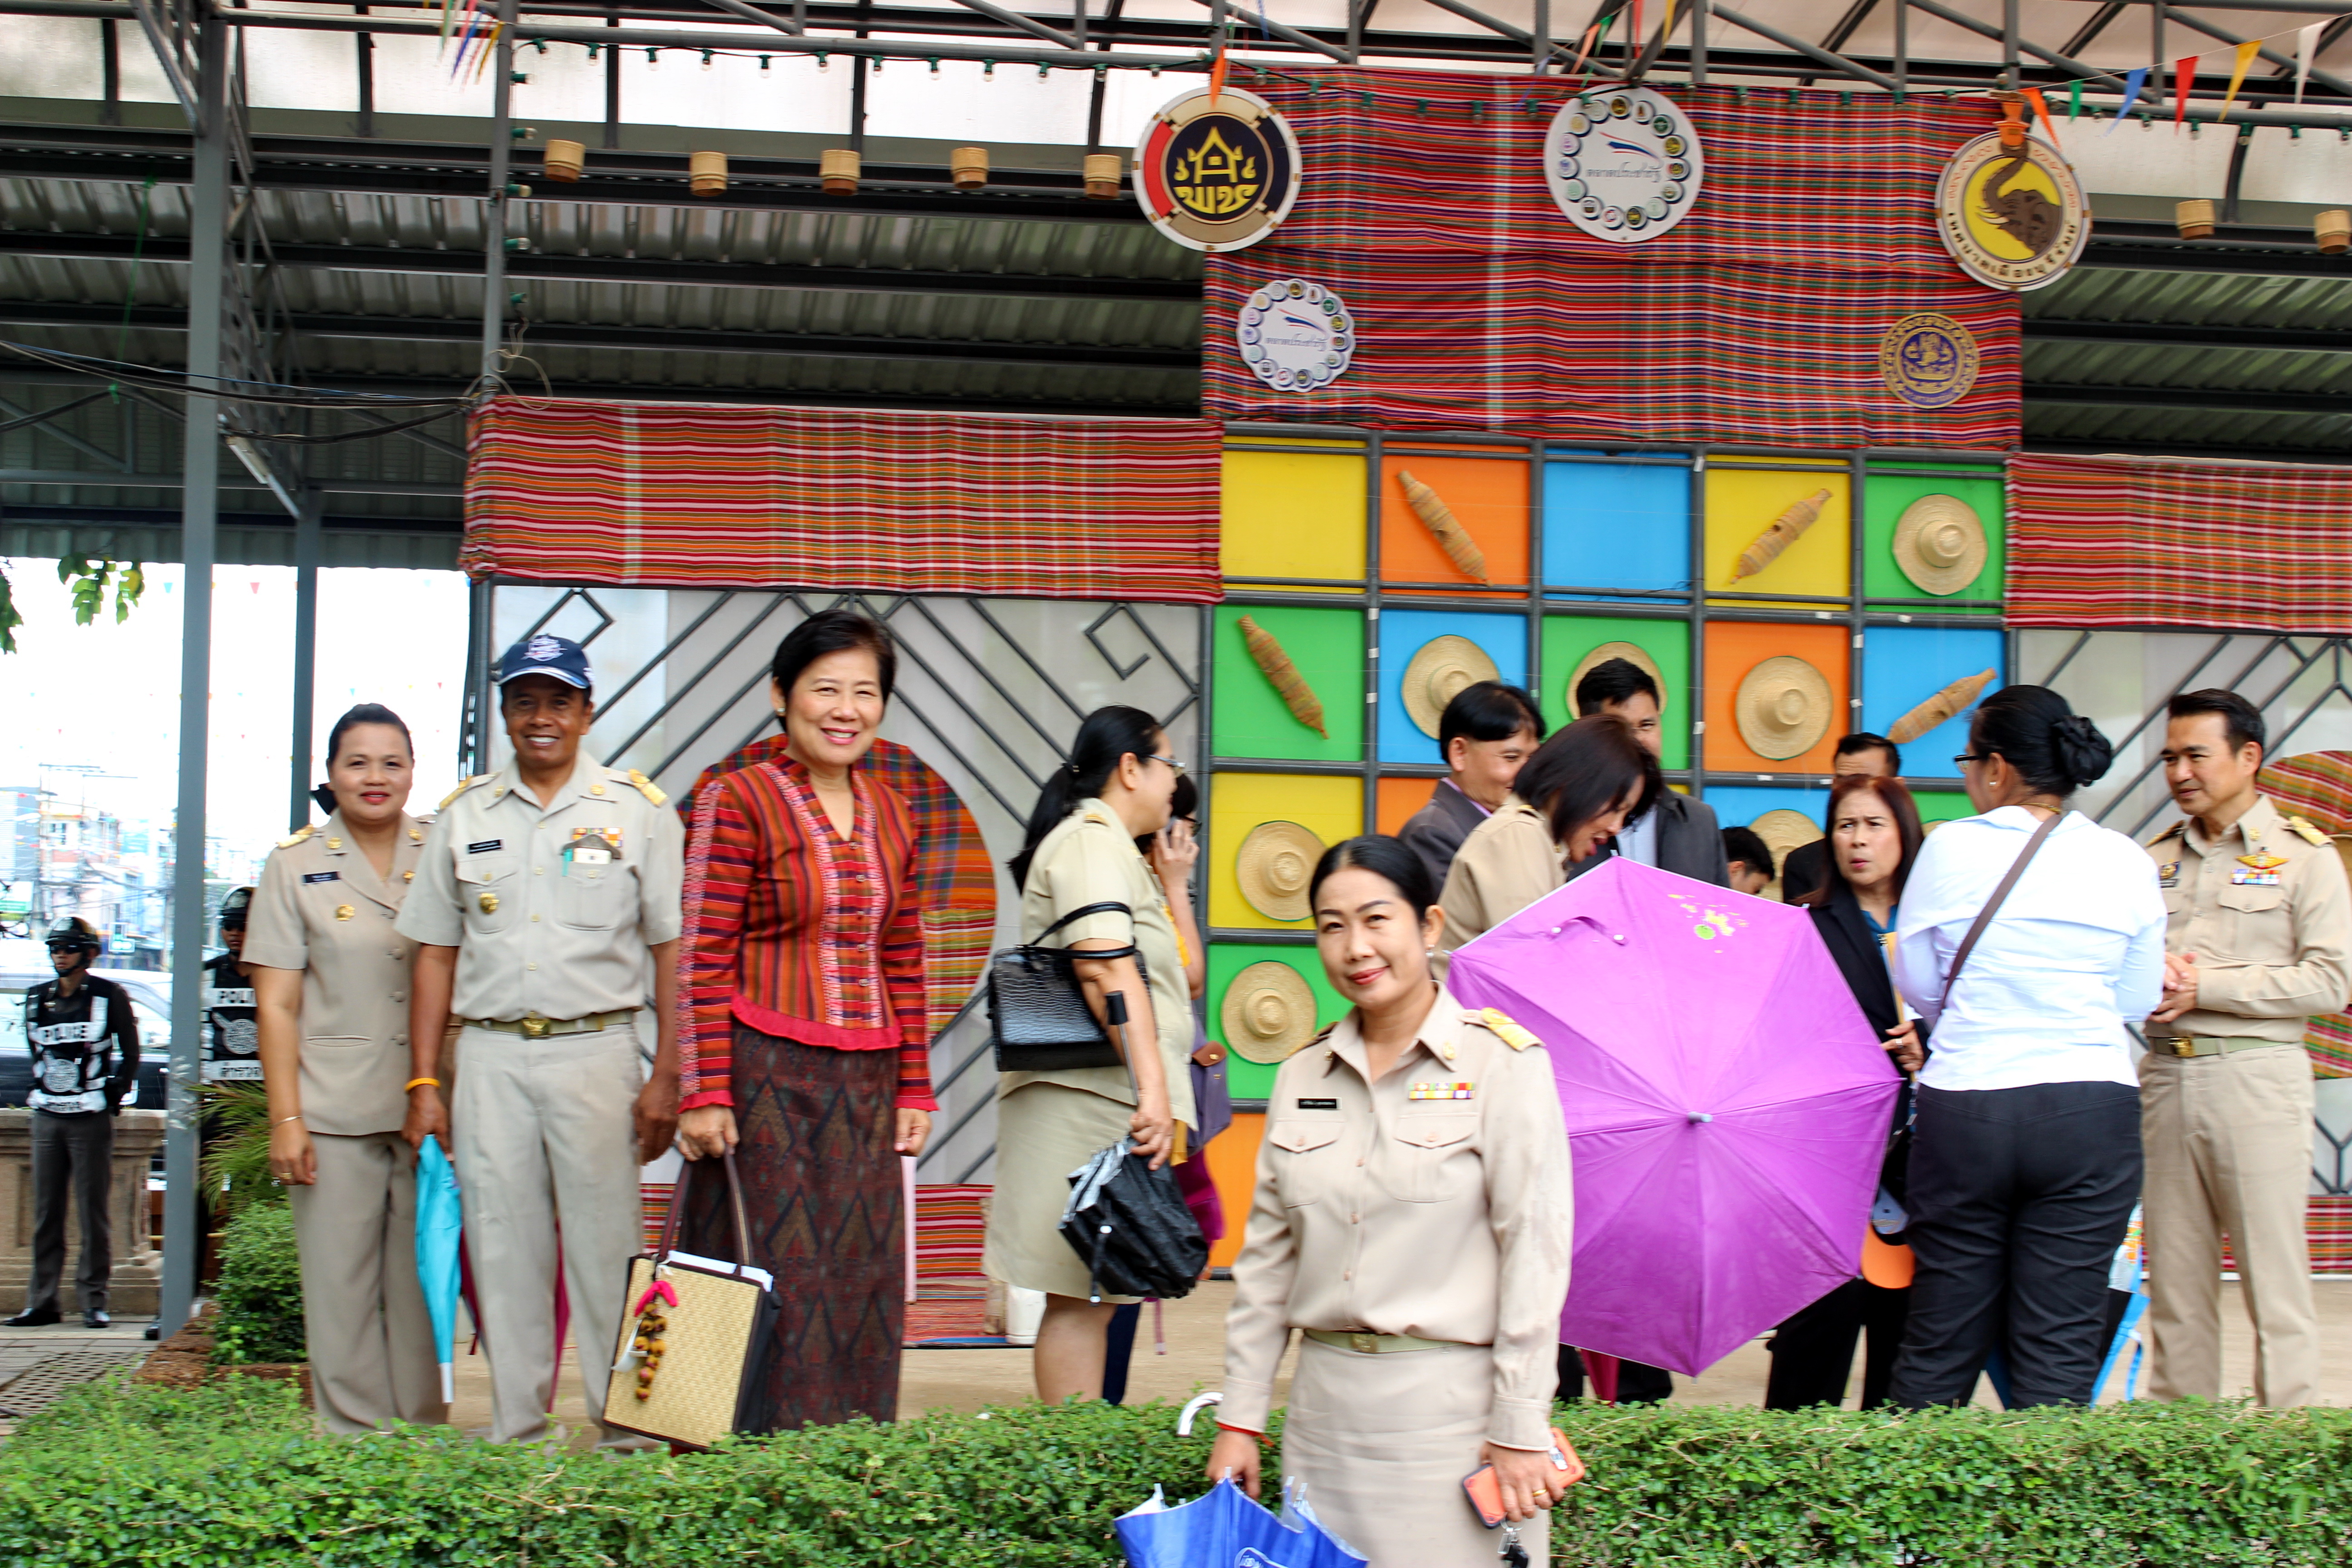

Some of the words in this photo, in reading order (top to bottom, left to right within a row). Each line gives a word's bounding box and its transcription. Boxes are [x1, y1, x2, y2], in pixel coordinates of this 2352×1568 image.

[1948, 212, 2077, 278] เทศบาลเมืองบุรีรัมย์
